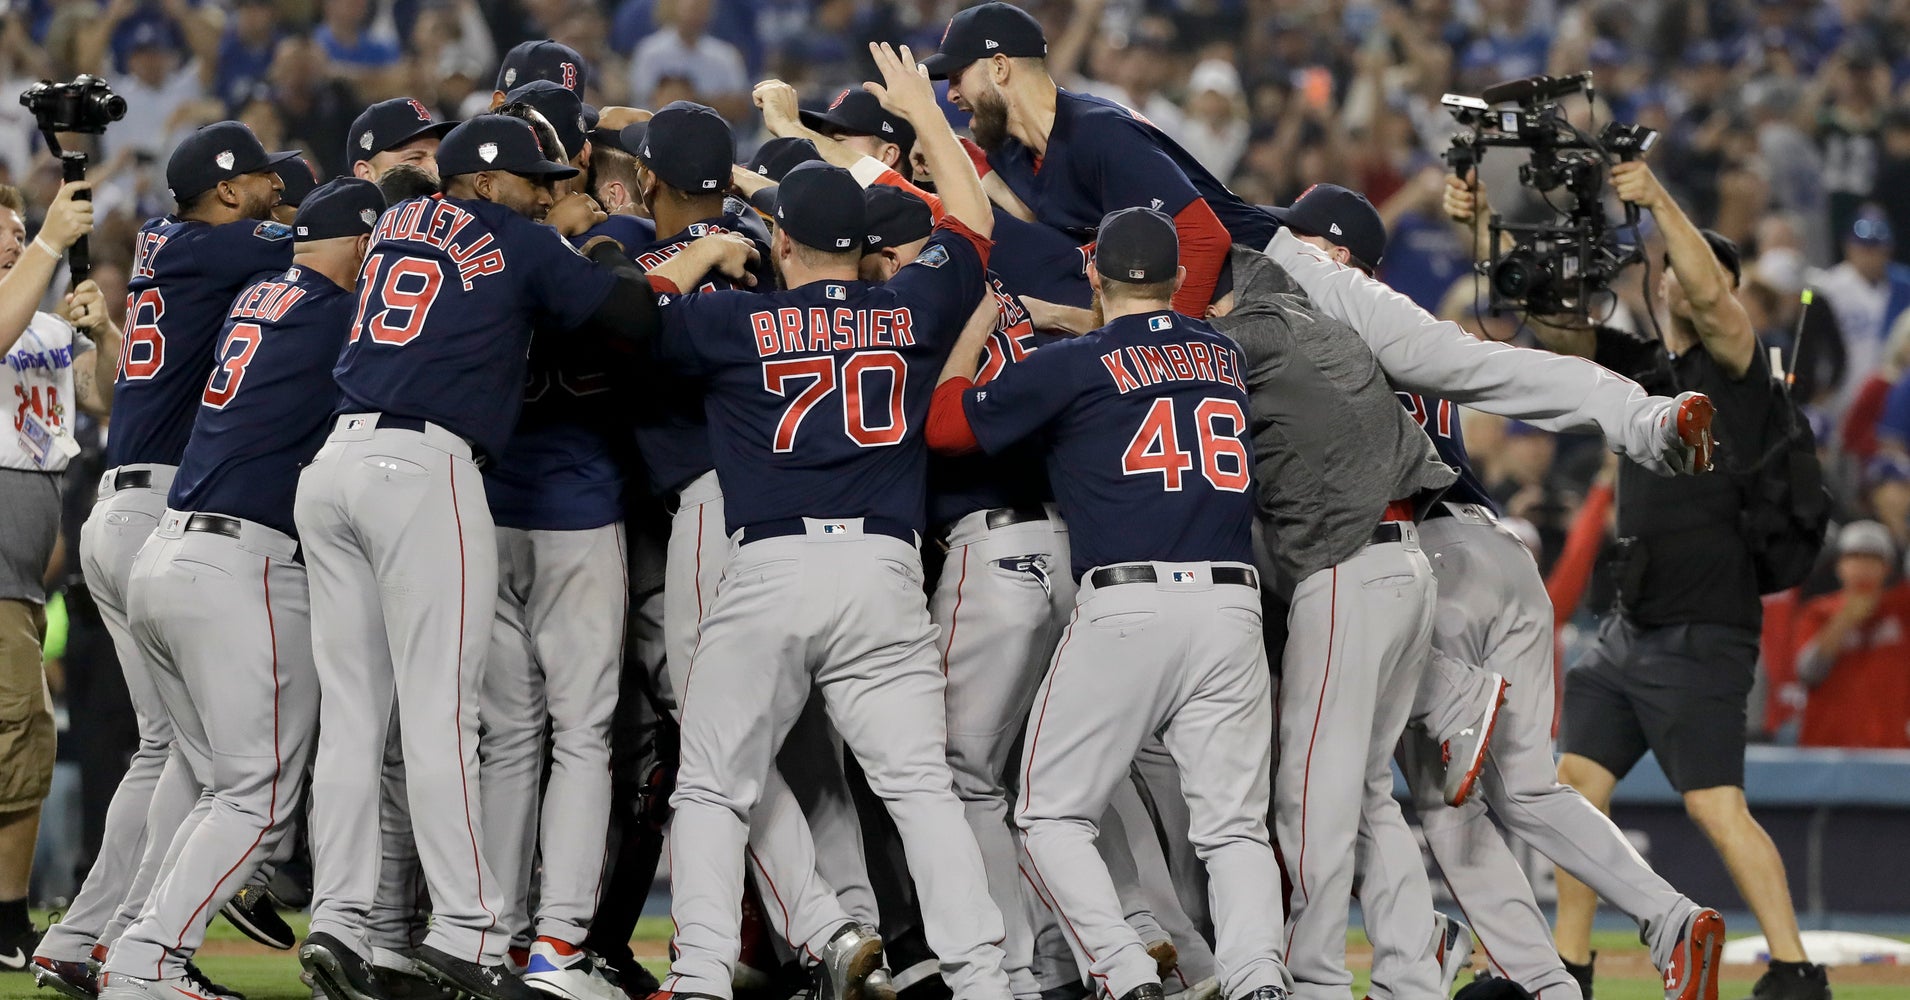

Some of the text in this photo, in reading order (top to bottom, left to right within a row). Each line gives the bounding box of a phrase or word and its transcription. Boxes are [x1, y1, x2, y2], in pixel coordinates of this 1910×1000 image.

[560, 62, 578, 91] B
[448, 232, 506, 292] JR.
[230, 281, 307, 322] LEON
[349, 253, 444, 346] 19
[750, 307, 916, 357] BRASIER
[202, 322, 263, 410] 3
[1101, 342, 1246, 395] KIMBREL
[762, 350, 908, 453] 70
[1121, 397, 1251, 494] 46
